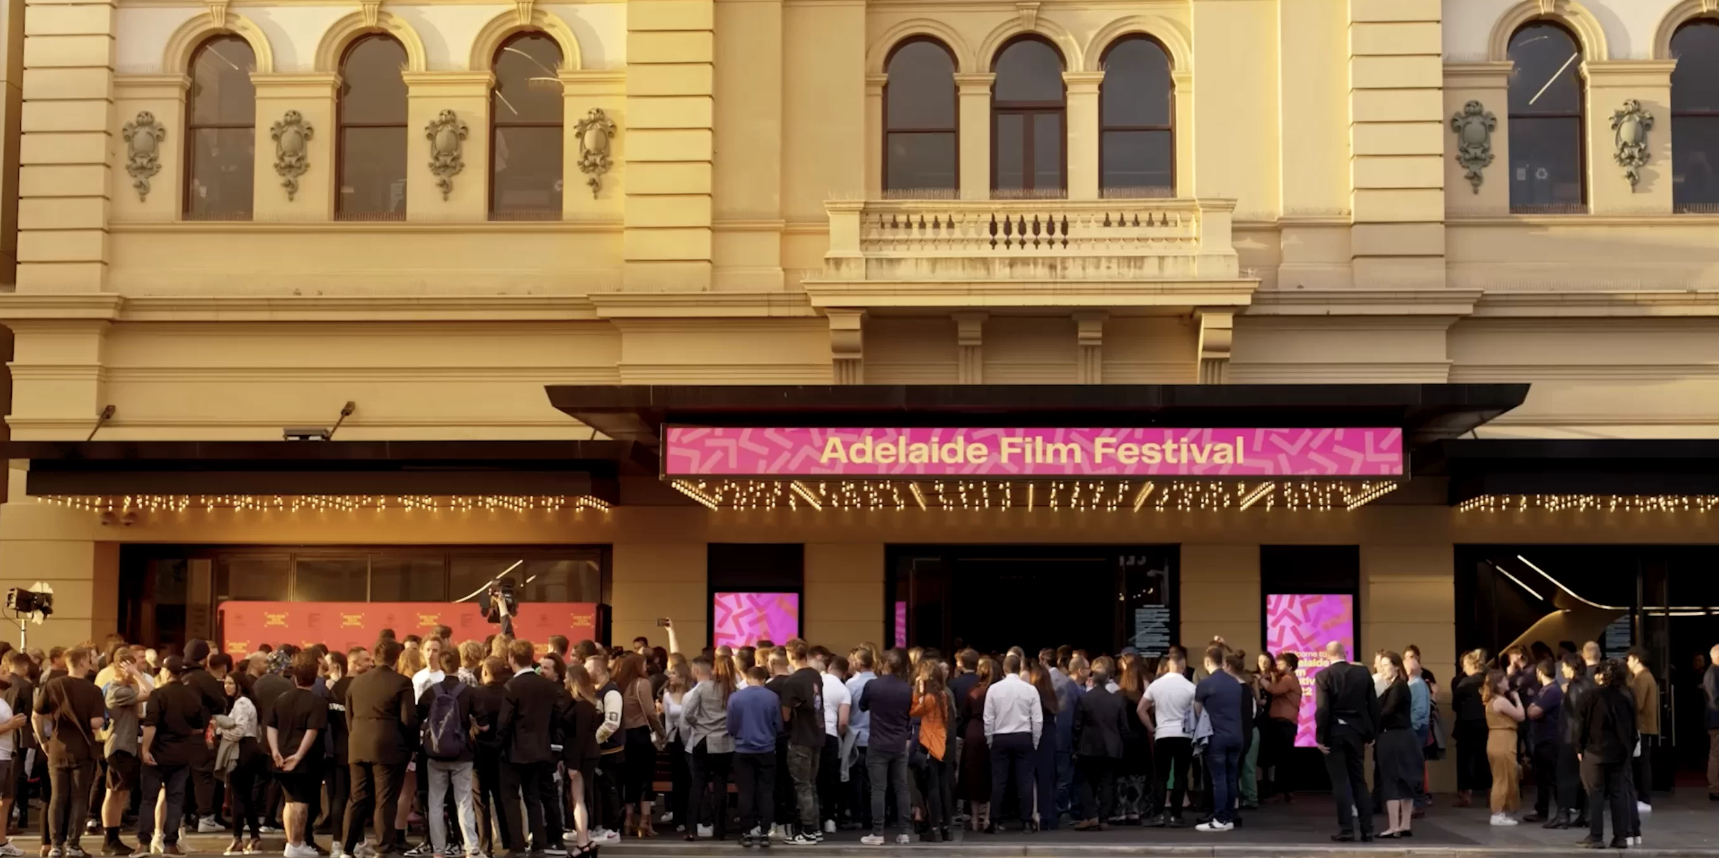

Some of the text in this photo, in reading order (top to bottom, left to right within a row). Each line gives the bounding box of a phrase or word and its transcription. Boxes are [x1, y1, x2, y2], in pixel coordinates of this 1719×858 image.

[820, 435, 1245, 464] Adelaide Film Festival
